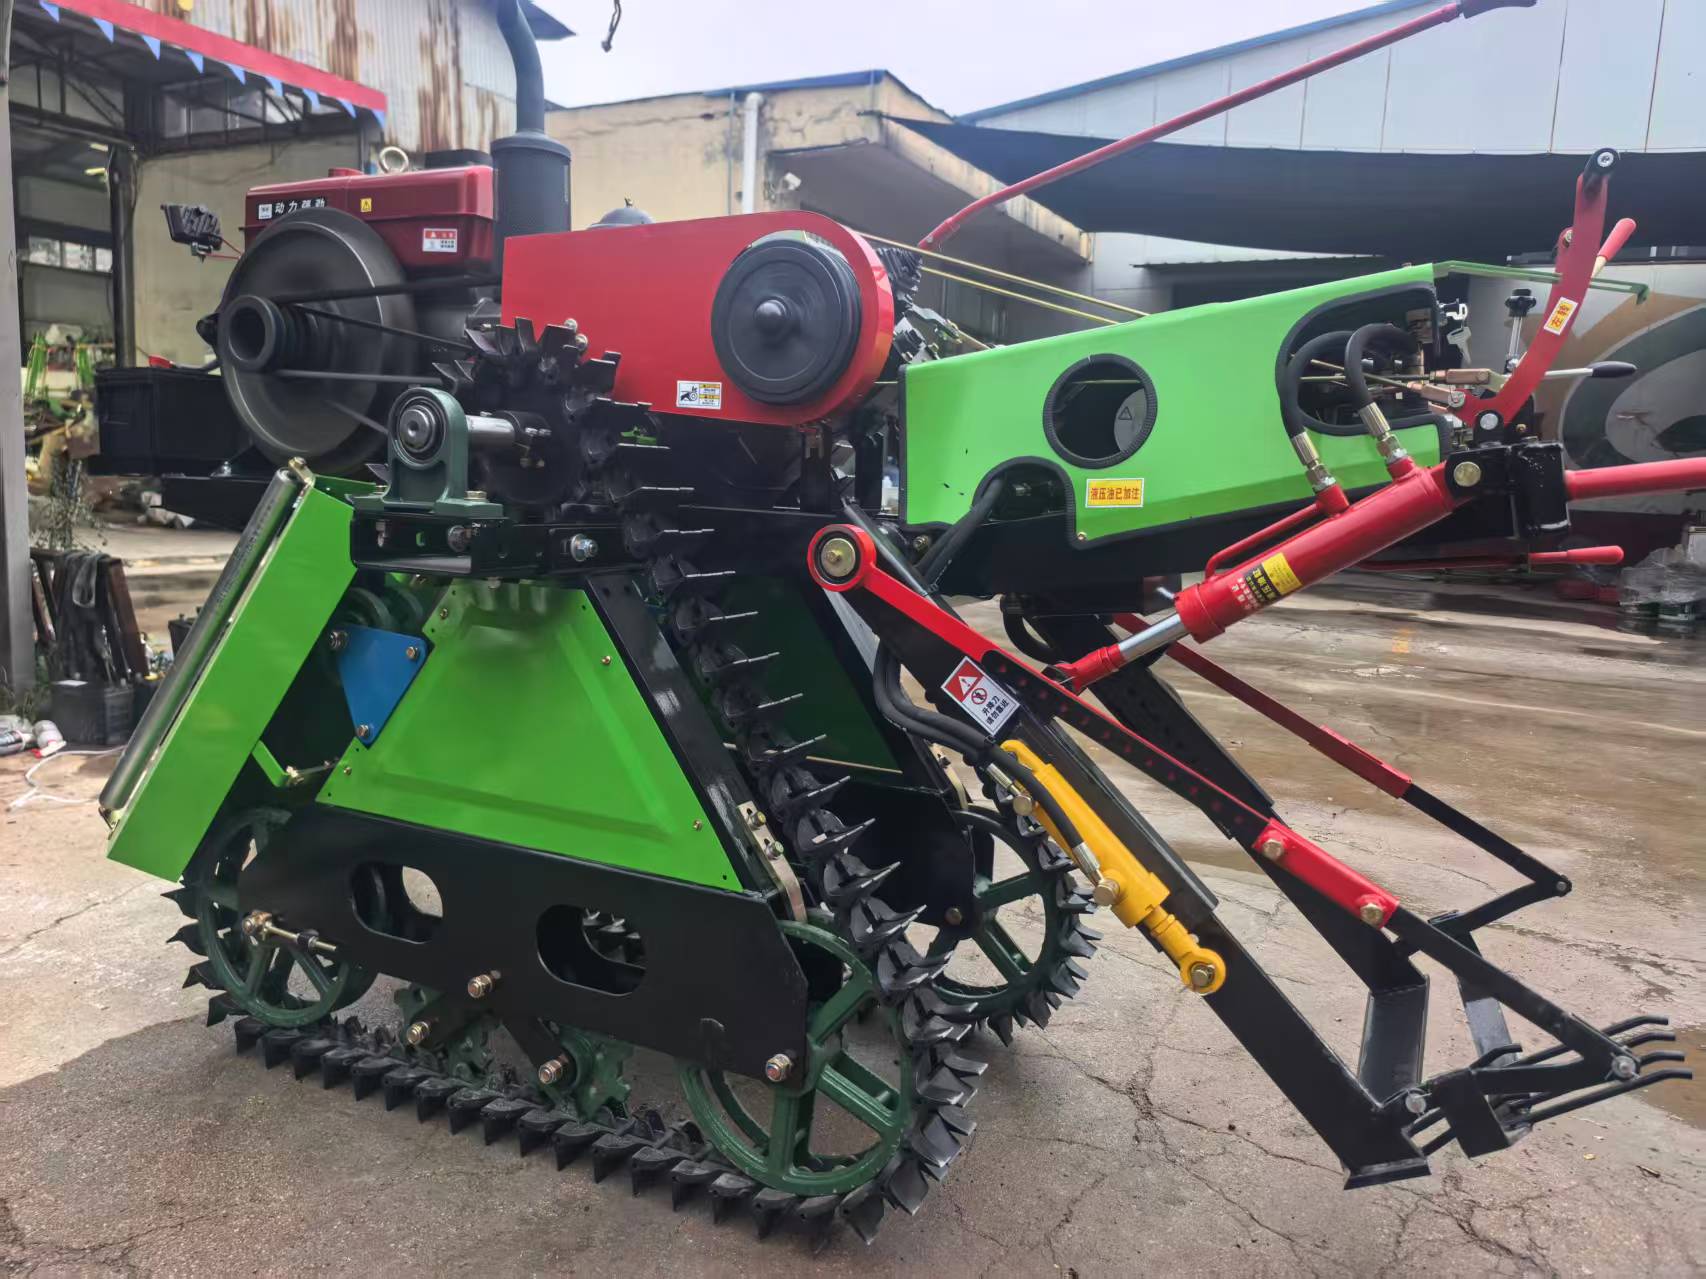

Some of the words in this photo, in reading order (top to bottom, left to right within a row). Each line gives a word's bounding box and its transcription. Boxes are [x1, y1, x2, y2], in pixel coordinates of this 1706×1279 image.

[1091, 486, 1139, 500] 液压油已加注
[986, 698, 1009, 725] 请勿靠近
